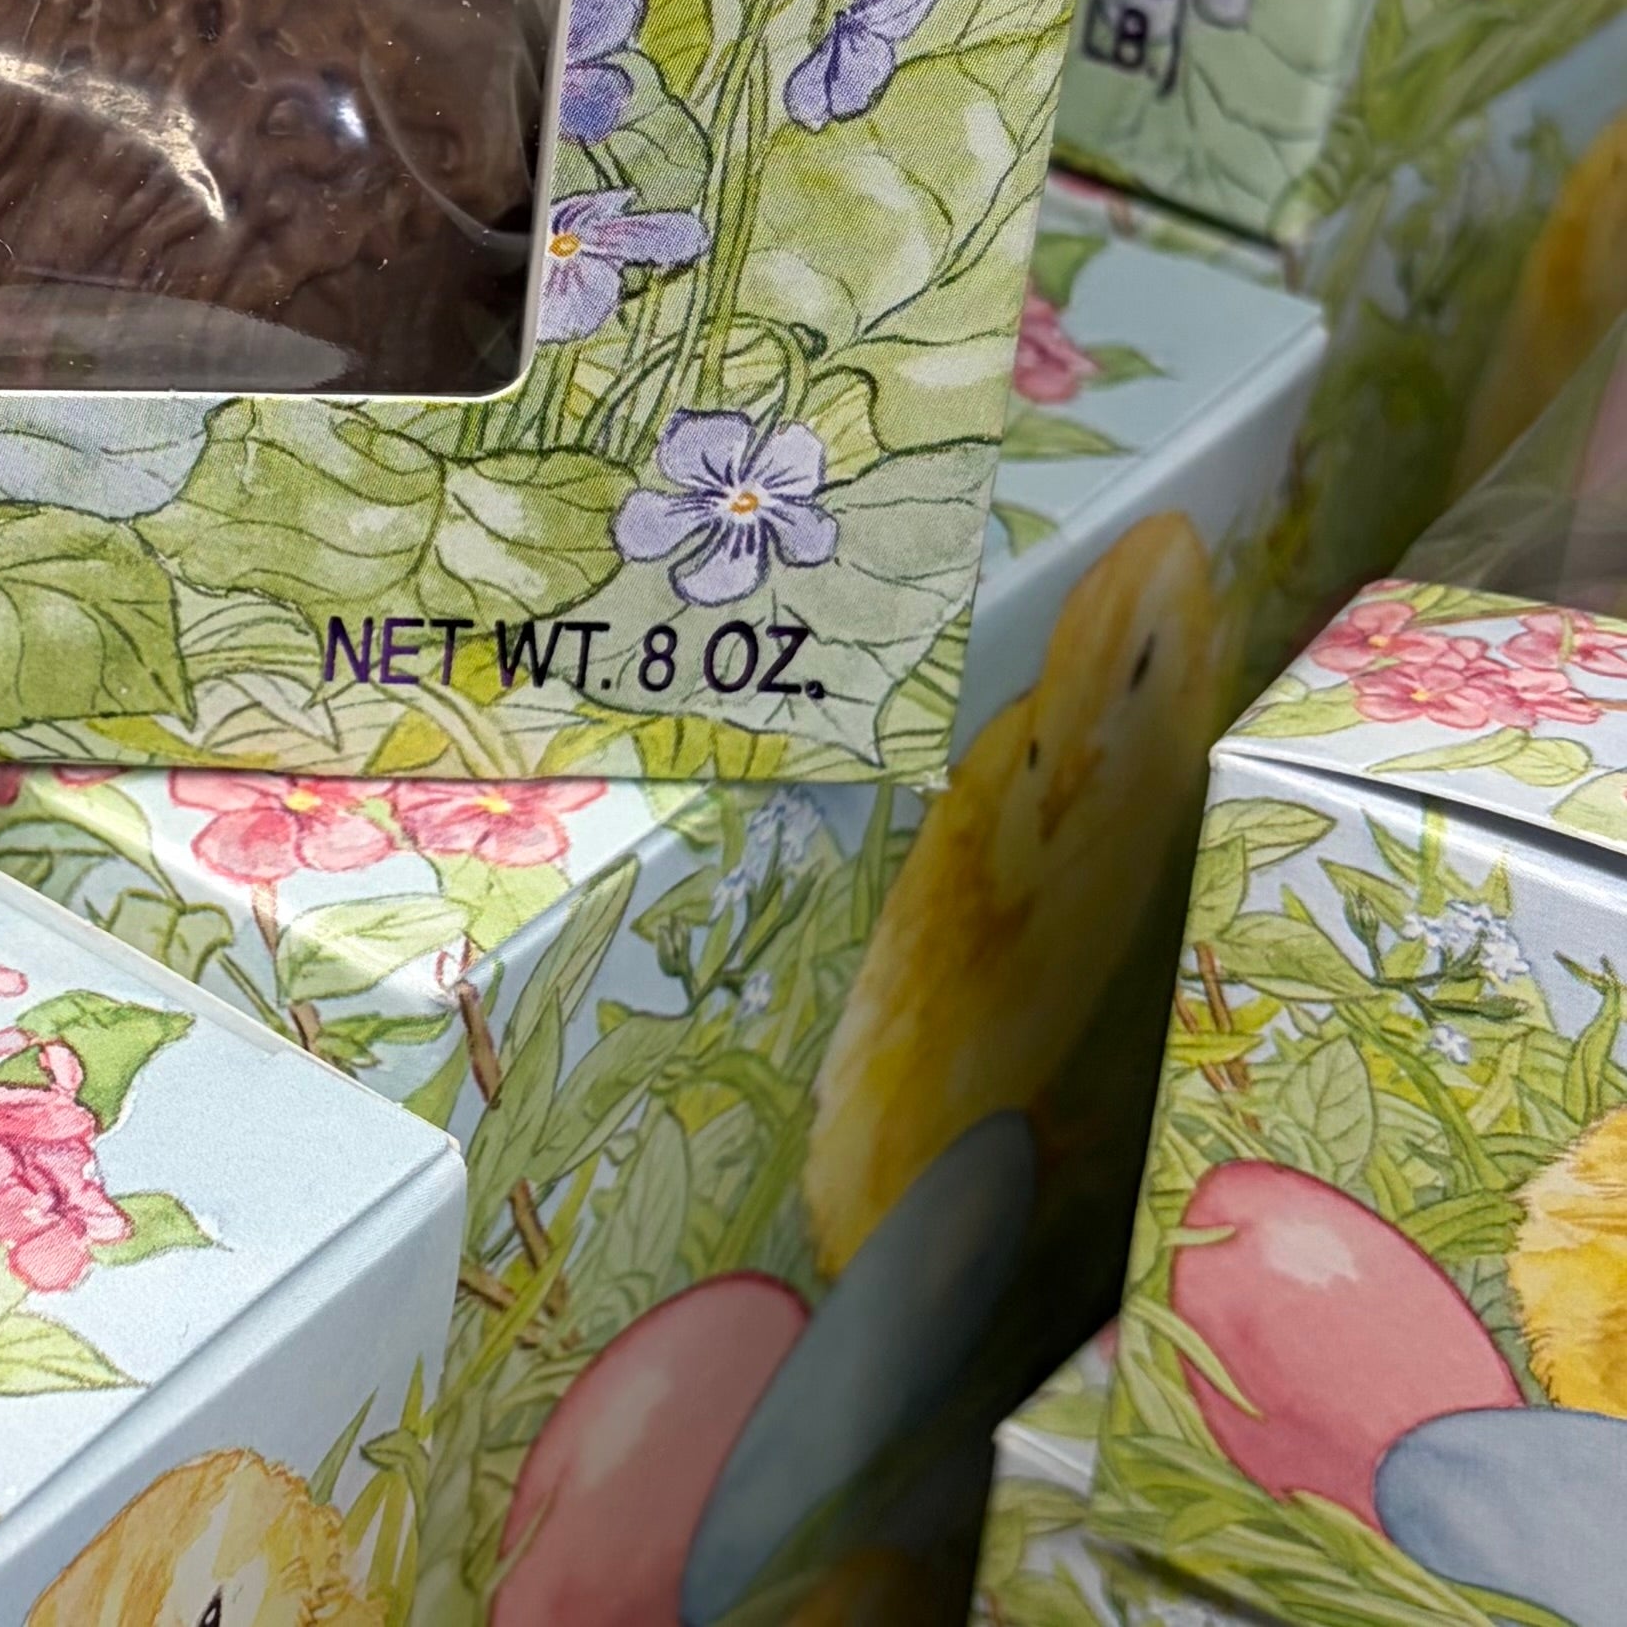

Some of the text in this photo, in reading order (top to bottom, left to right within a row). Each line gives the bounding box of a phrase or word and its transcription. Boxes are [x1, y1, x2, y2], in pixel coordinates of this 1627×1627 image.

[324, 615, 826, 700] NET WT. 8 OZ.
